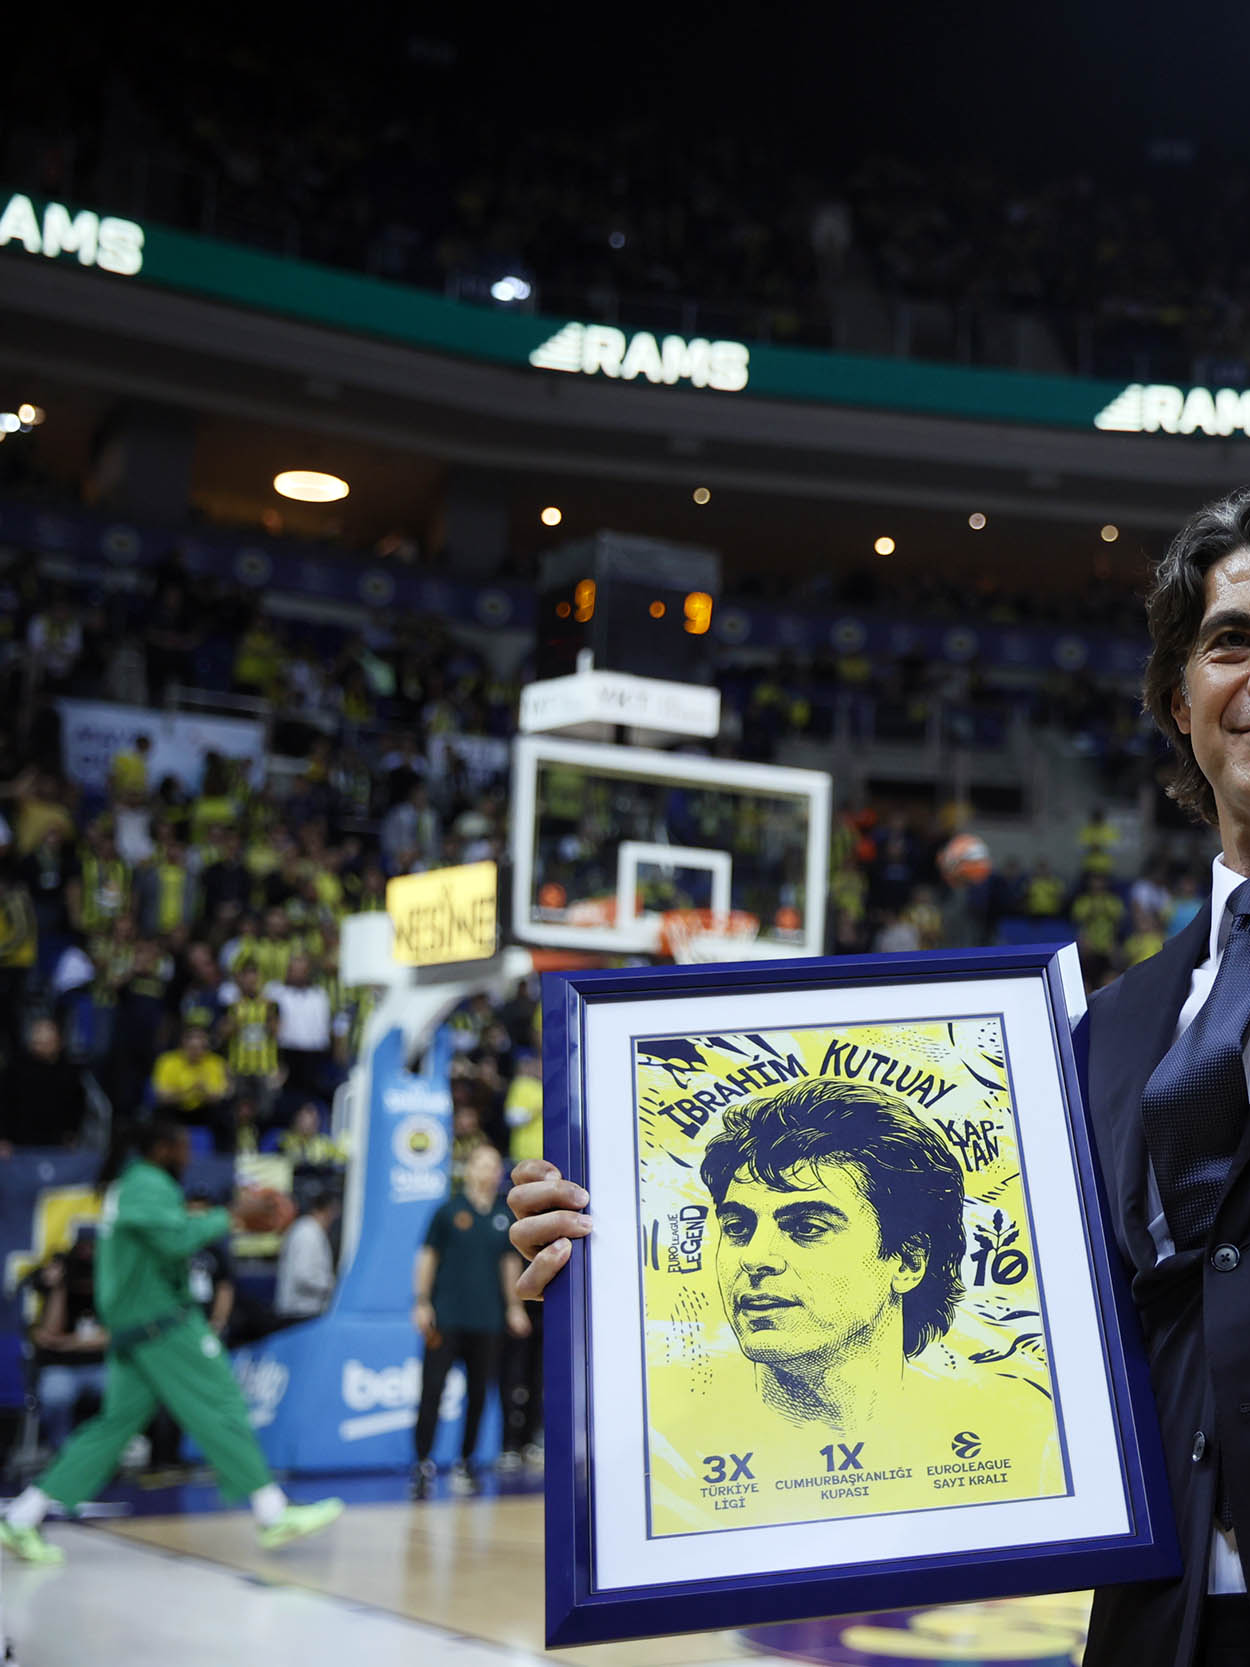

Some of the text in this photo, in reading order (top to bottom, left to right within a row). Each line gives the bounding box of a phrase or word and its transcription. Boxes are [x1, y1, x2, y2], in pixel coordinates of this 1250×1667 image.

[582, 323, 750, 391] RAMS
[819, 1038, 958, 1109] KUTLUAY
[657, 1053, 810, 1140] İBRAHİM
[667, 1213, 681, 1273] EUROLEAGUE
[970, 1248, 1029, 1287] 10
[702, 1452, 756, 1484] 3X
[819, 1441, 865, 1473] 1X
[927, 1458, 1012, 1476] EUROLEAGUE
[700, 1482, 759, 1498] TÜRKİYE
[775, 1466, 913, 1491] CUMHURBAŞKANLIĞI
[821, 1486, 870, 1500] KUPASI
[933, 1472, 1008, 1489] SAYI KRALI
[714, 1495, 746, 1510] LİGİ
